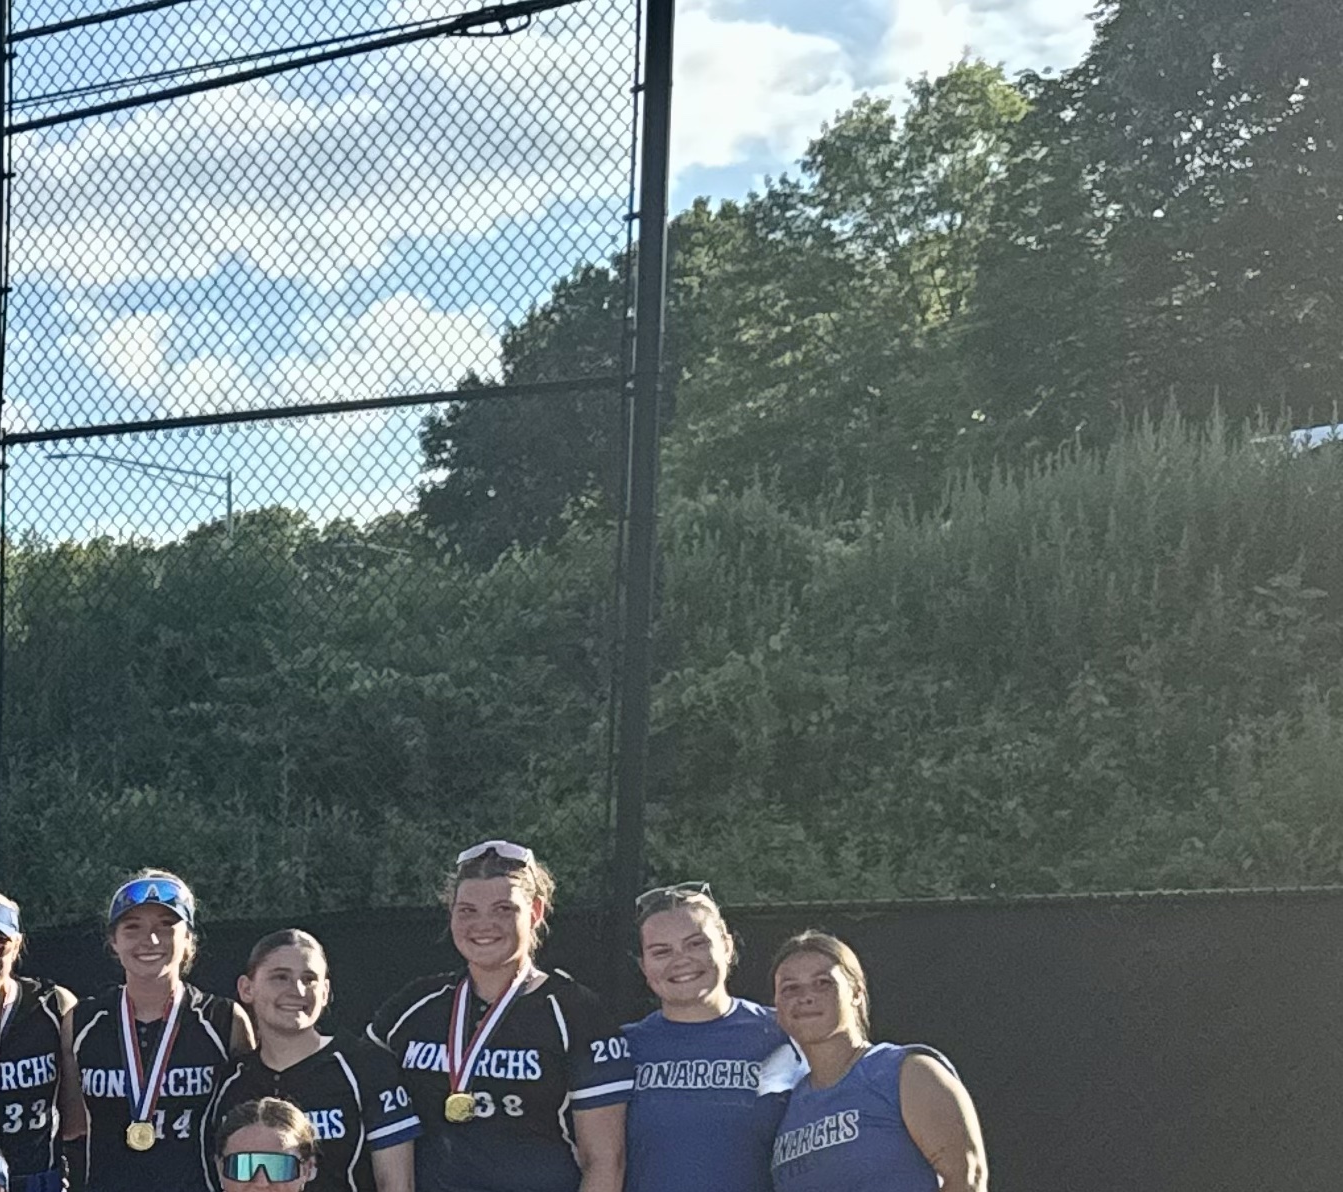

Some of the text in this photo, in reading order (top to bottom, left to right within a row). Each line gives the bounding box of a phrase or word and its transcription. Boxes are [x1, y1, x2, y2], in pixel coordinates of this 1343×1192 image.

[401, 1040, 543, 1082] MONRCHS
[634, 1060, 762, 1092] ONARCHS
[379, 1085, 413, 1113] 20
[2, 1098, 48, 1134] 33
[152, 1108, 193, 1140] 14
